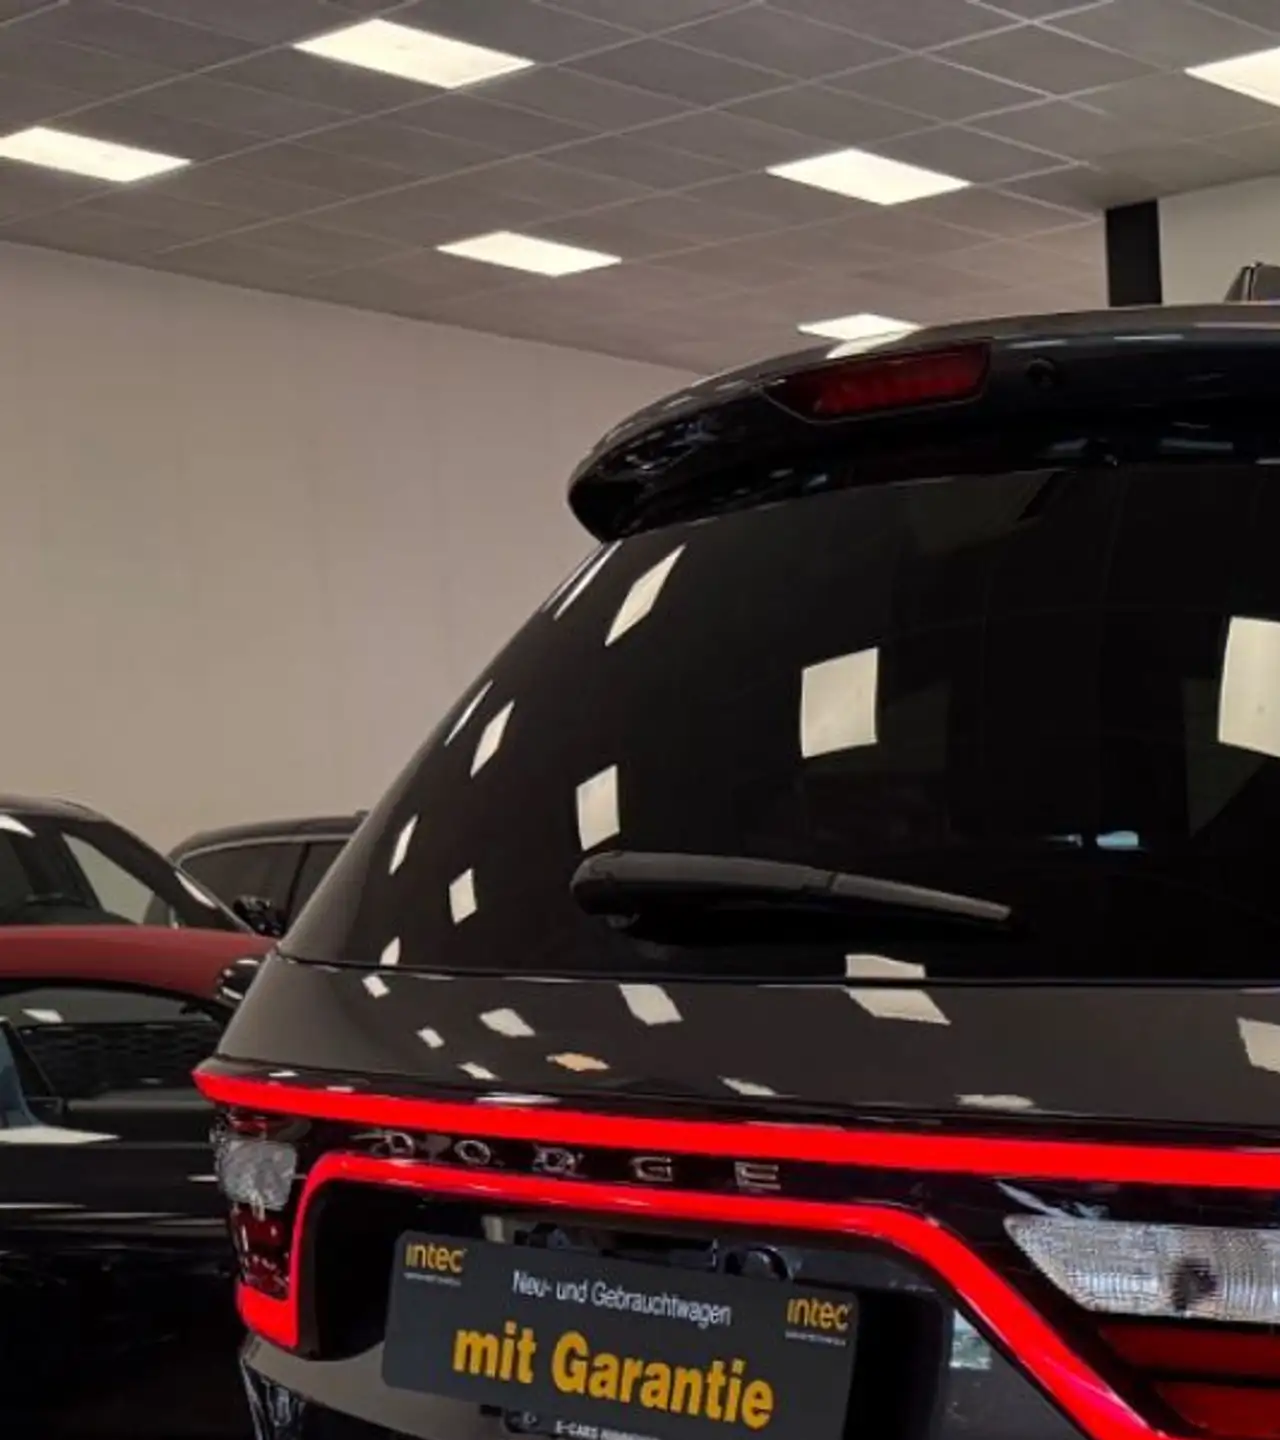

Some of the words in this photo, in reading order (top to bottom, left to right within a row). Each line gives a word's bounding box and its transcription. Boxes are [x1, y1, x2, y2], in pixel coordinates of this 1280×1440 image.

[384, 1128, 781, 1192] DODGE
[404, 1241, 466, 1275] intec
[512, 1269, 551, 1298] Neu-
[555, 1279, 589, 1303] und
[591, 1281, 731, 1328] Gebrauchtwagen
[786, 1296, 850, 1332] intec
[452, 1319, 537, 1384] mit
[552, 1330, 774, 1430] Garantie
